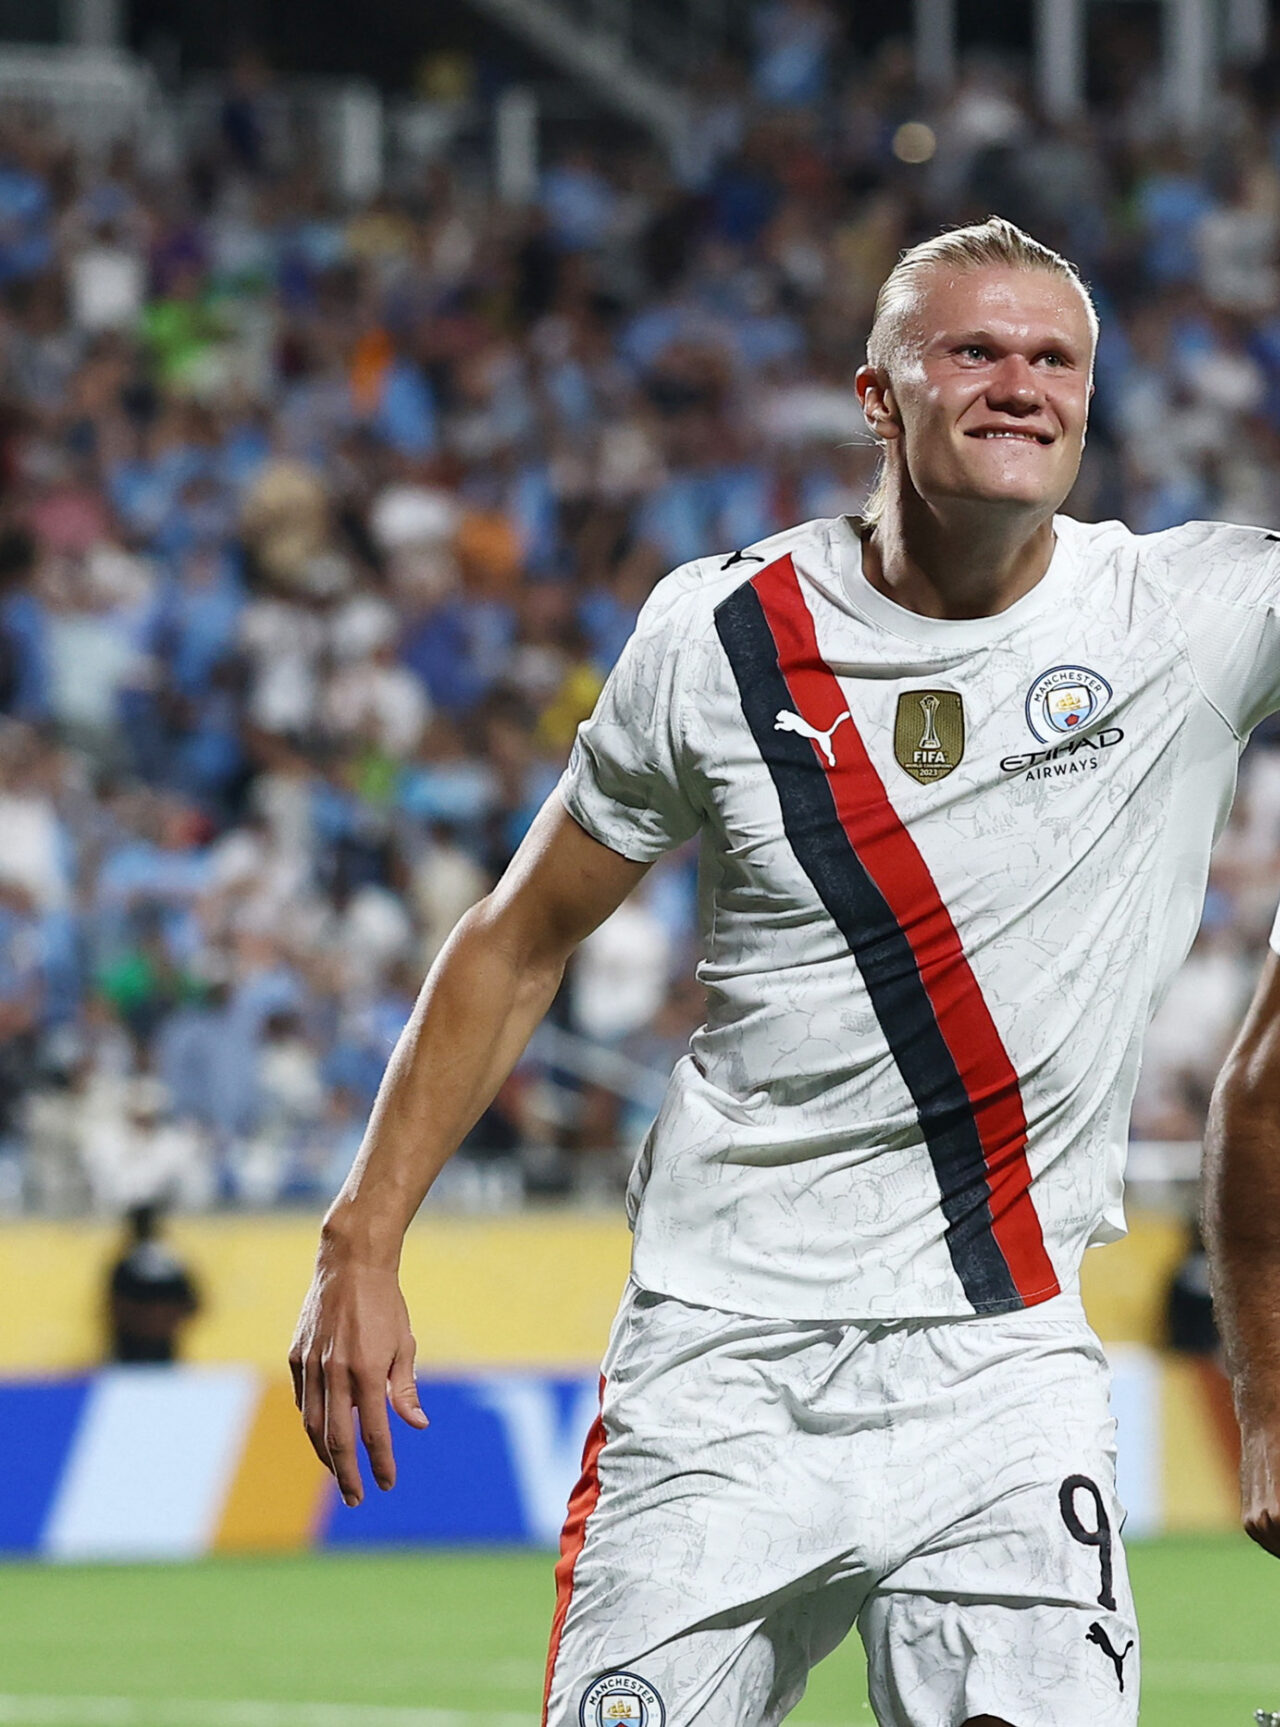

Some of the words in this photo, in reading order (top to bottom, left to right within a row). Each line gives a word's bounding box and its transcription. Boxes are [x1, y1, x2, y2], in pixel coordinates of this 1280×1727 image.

[1033, 671, 1103, 703] MANCHESTER
[913, 751, 946, 763] FIFA
[999, 727, 1125, 772] ETIHAD
[919, 769, 938, 777] 2023
[1025, 757, 1099, 782] AIRWAYS
[1058, 1473, 1117, 1612] 9
[588, 1678, 656, 1706] MANCHESTER
